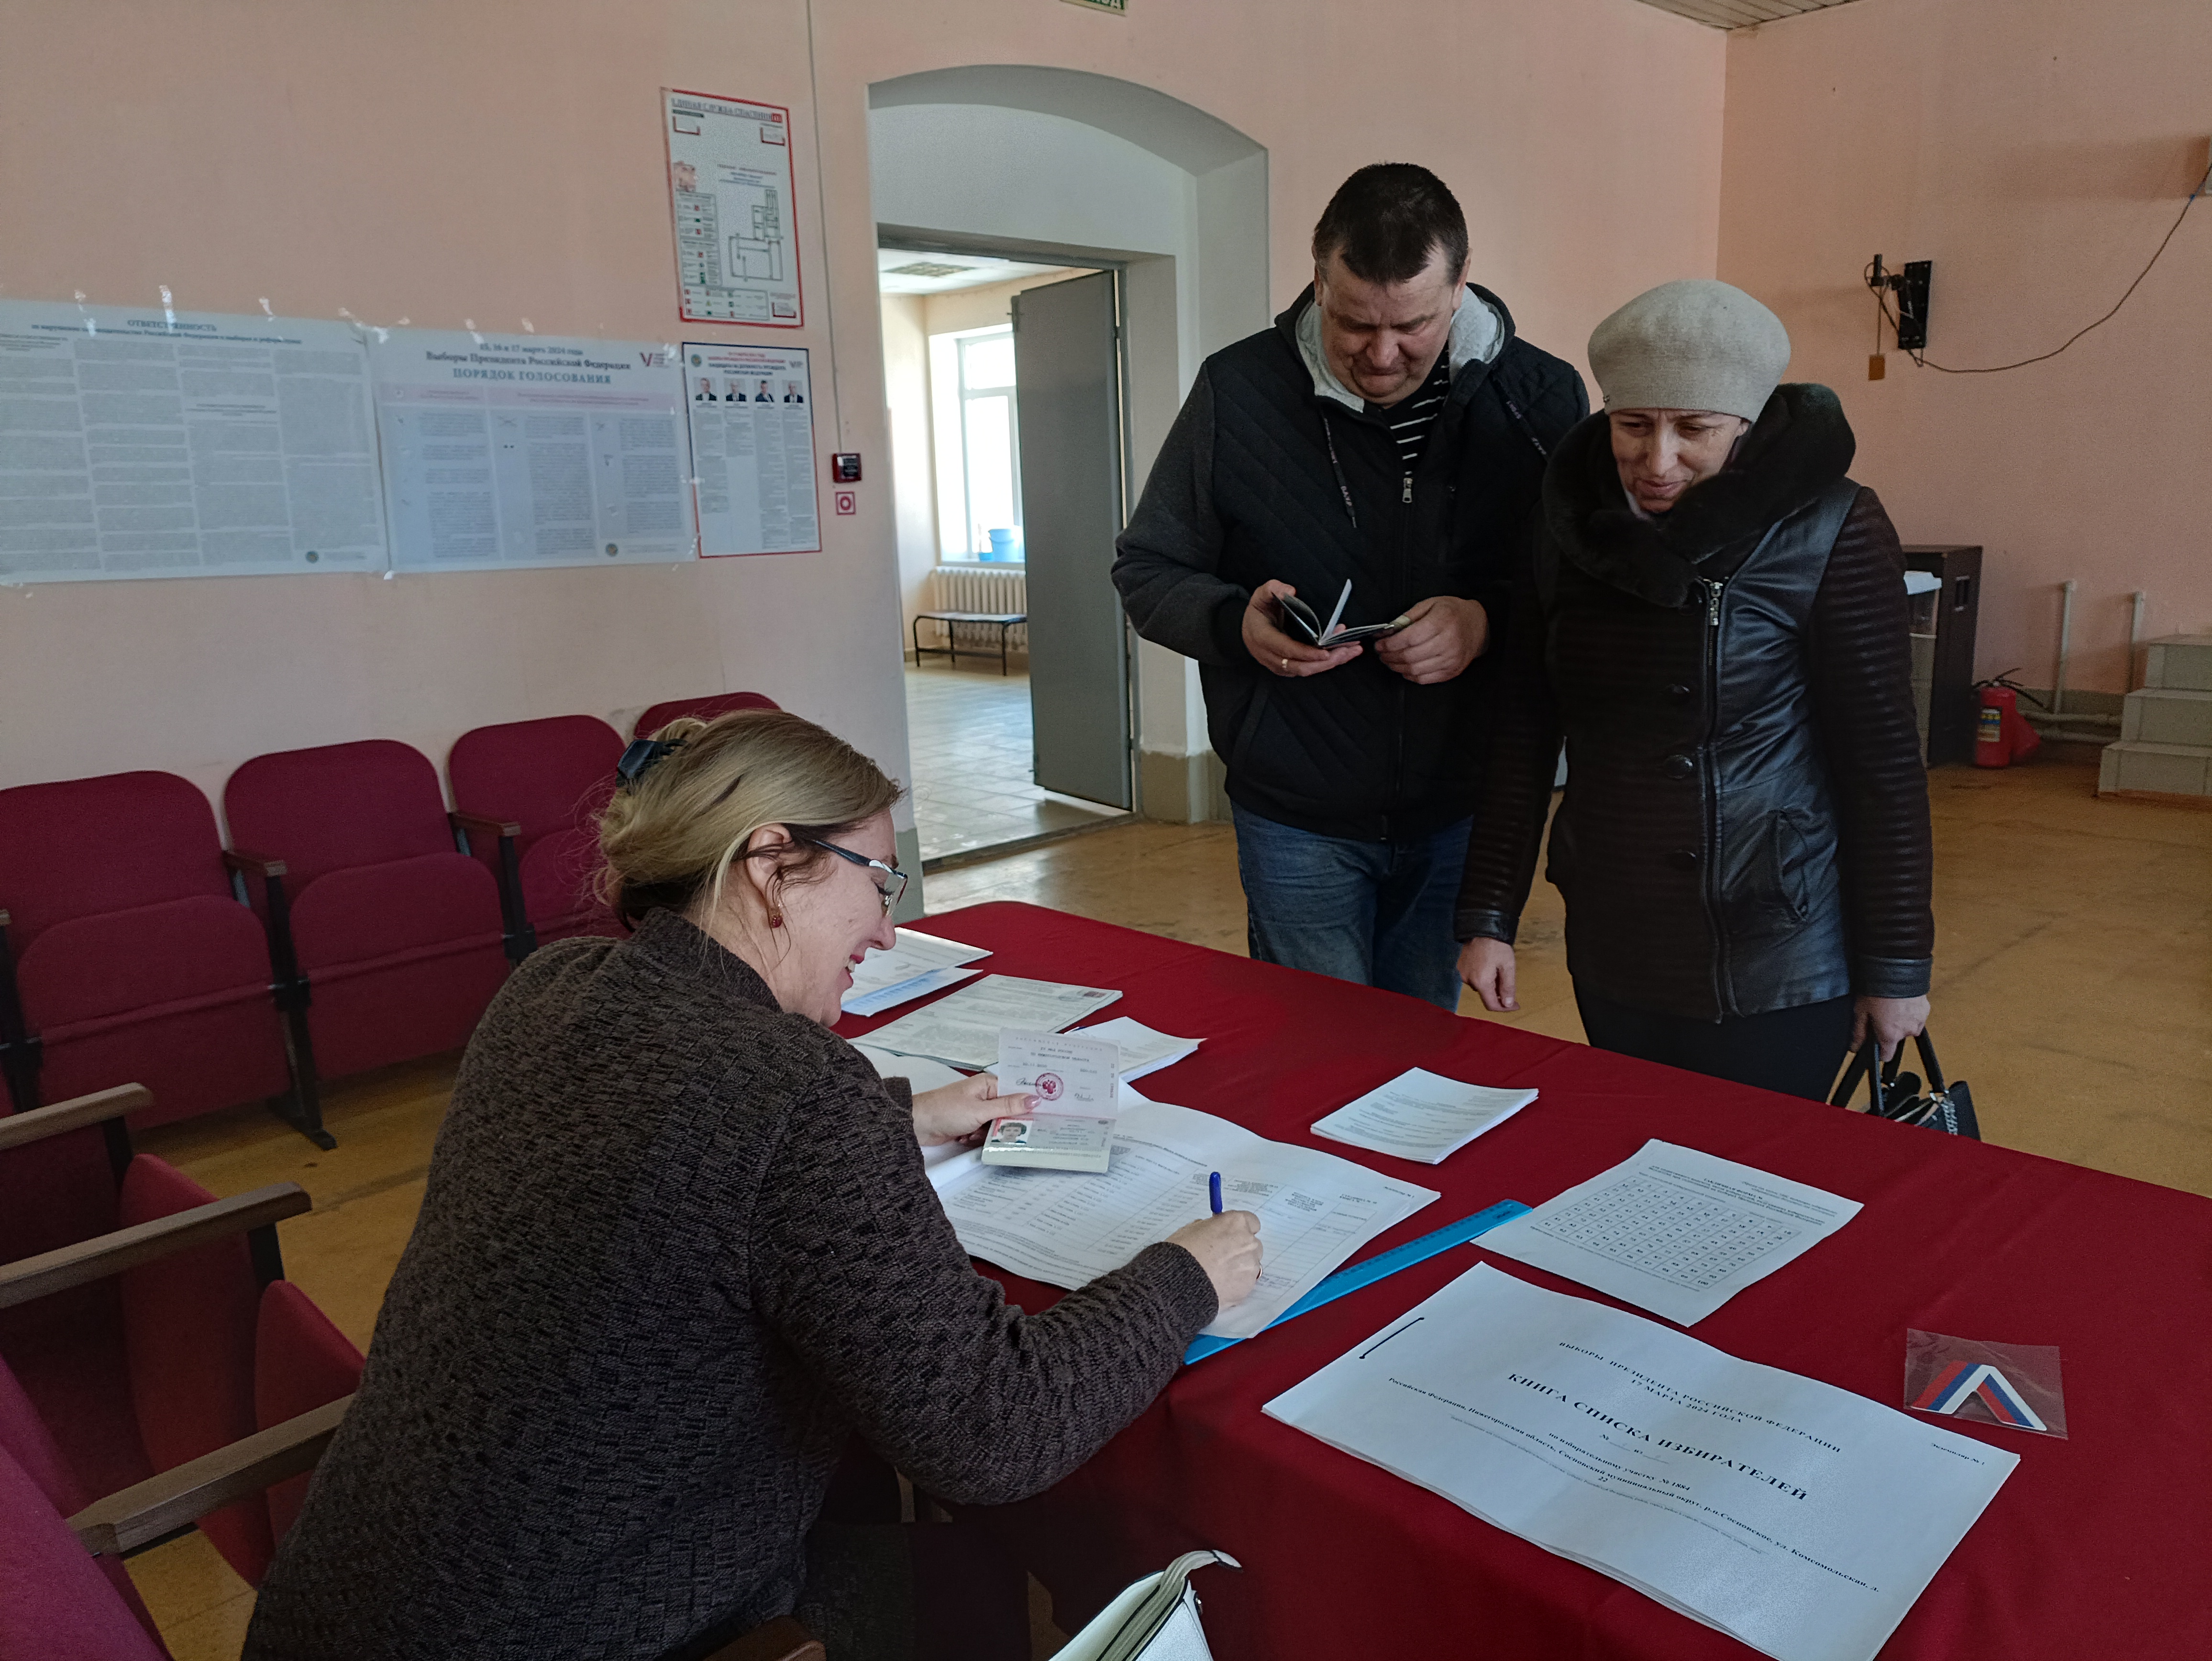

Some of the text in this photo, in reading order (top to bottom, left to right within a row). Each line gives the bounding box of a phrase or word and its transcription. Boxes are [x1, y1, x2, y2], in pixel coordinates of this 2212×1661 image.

[426, 350, 468, 364] Выборы
[470, 353, 527, 365] Президента
[528, 356, 582, 367] Российской
[453, 368, 611, 384] ПОРЯДОК ГОЛОСОВАНИЯ
[1559, 1342, 1841, 1452] ВЫБОРЫ ПРЕЗИДЕНТА РОССИЙСКОЙ ФЕДЕРАЦИИ
[1644, 1385, 1681, 1405] МАРТА
[1685, 1403, 1709, 1413] 2024
[1712, 1411, 1741, 1423] ГОДА
[1507, 1373, 1807, 1500] КНИГА СПИСКА ИЗБИРАТЕЛЕЙ
[1930, 1442, 1969, 1460] Экземпляр
[1388, 1377, 1427, 1395] Российская
[1468, 1407, 1525, 1435] Нижегородская
[1558, 1450, 1605, 1475] Сосновский
[1607, 1473, 1675, 1497] муниципальный
[1774, 1541, 1788, 1550] ул.
[1791, 1548, 1868, 1588] Комсомольская,
[1559, 1438, 1622, 1470] избирательному
[1622, 1467, 1655, 1481] участку
[1671, 1482, 1691, 1491] 1884
